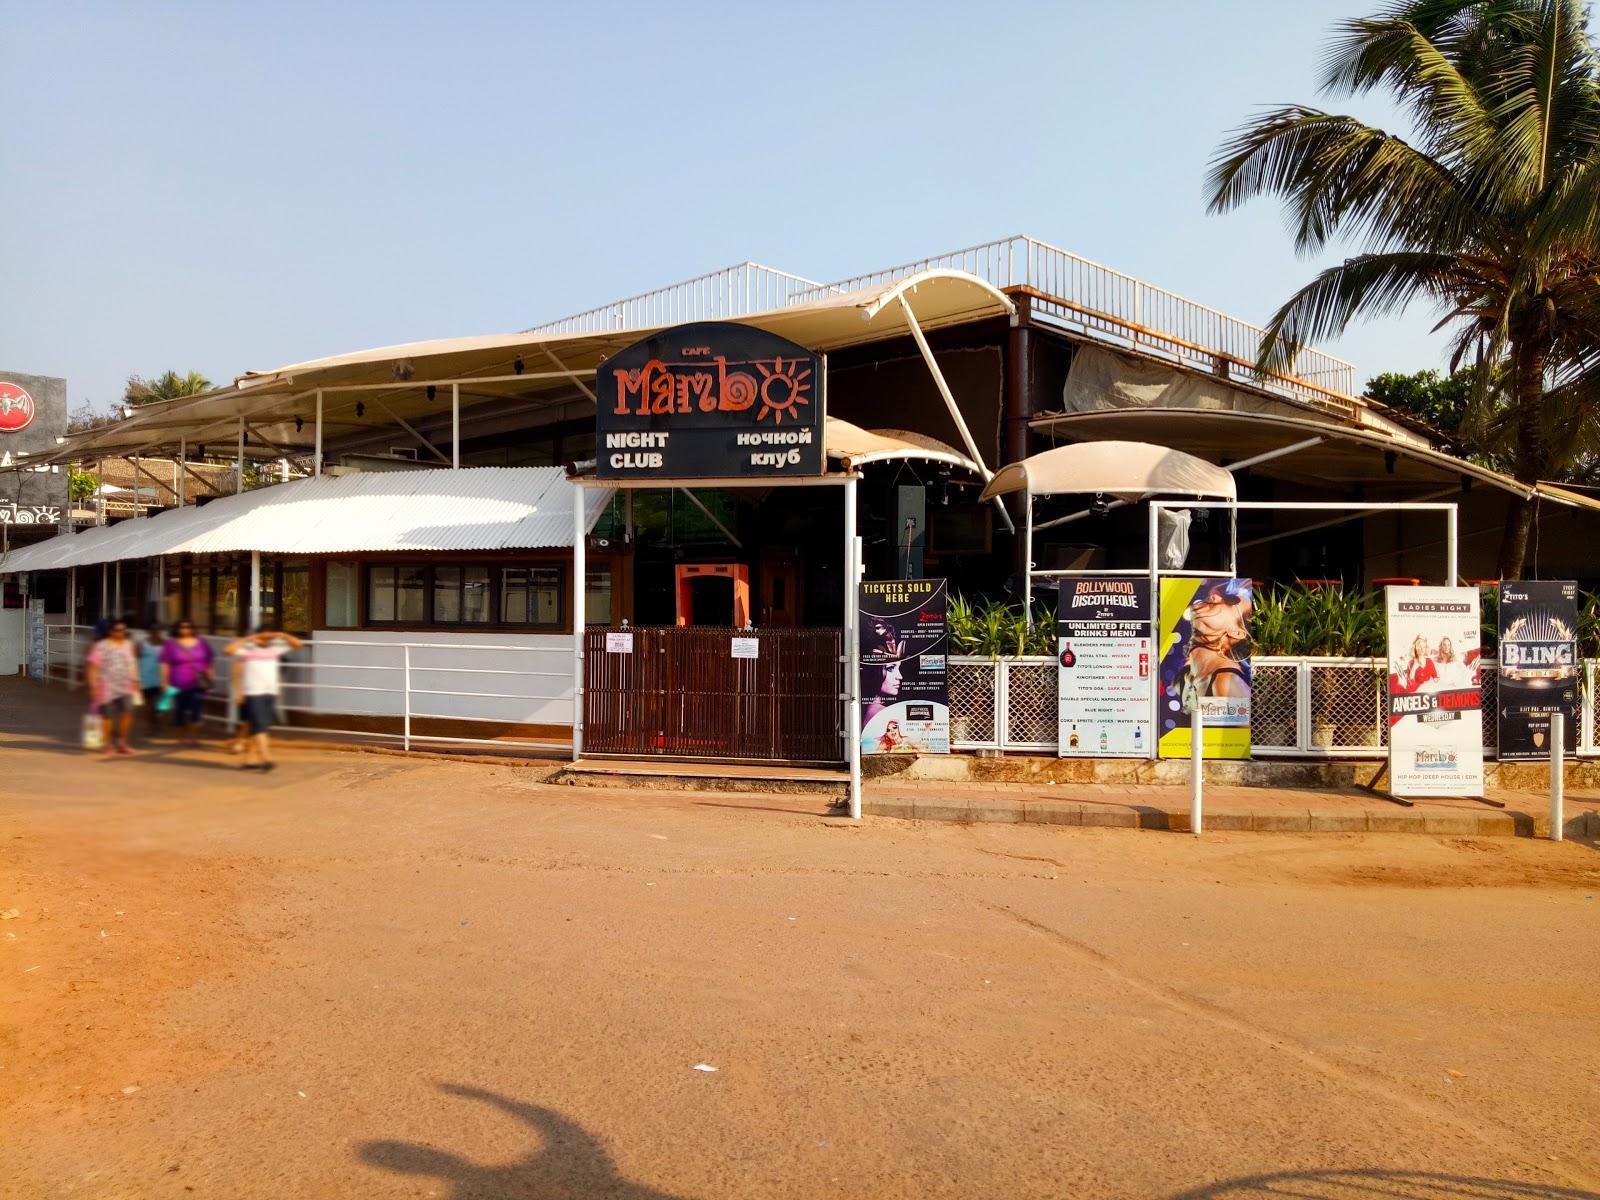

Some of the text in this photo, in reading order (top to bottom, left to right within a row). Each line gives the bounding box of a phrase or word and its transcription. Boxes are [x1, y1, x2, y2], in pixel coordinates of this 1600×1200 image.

[606, 432, 669, 448] NIGHT
[610, 453, 663, 468] CLUB
[864, 583, 932, 594] TICKETS SOLD
[1076, 582, 1134, 594] BOLLYWOOD
[886, 594, 910, 603] HERE
[1072, 595, 1139, 609] DISCOTHEQUE
[1505, 644, 1572, 664] BLING
[1393, 692, 1480, 712] ANGELS & DEMONS
[1423, 713, 1455, 722] WEDNESDAY
